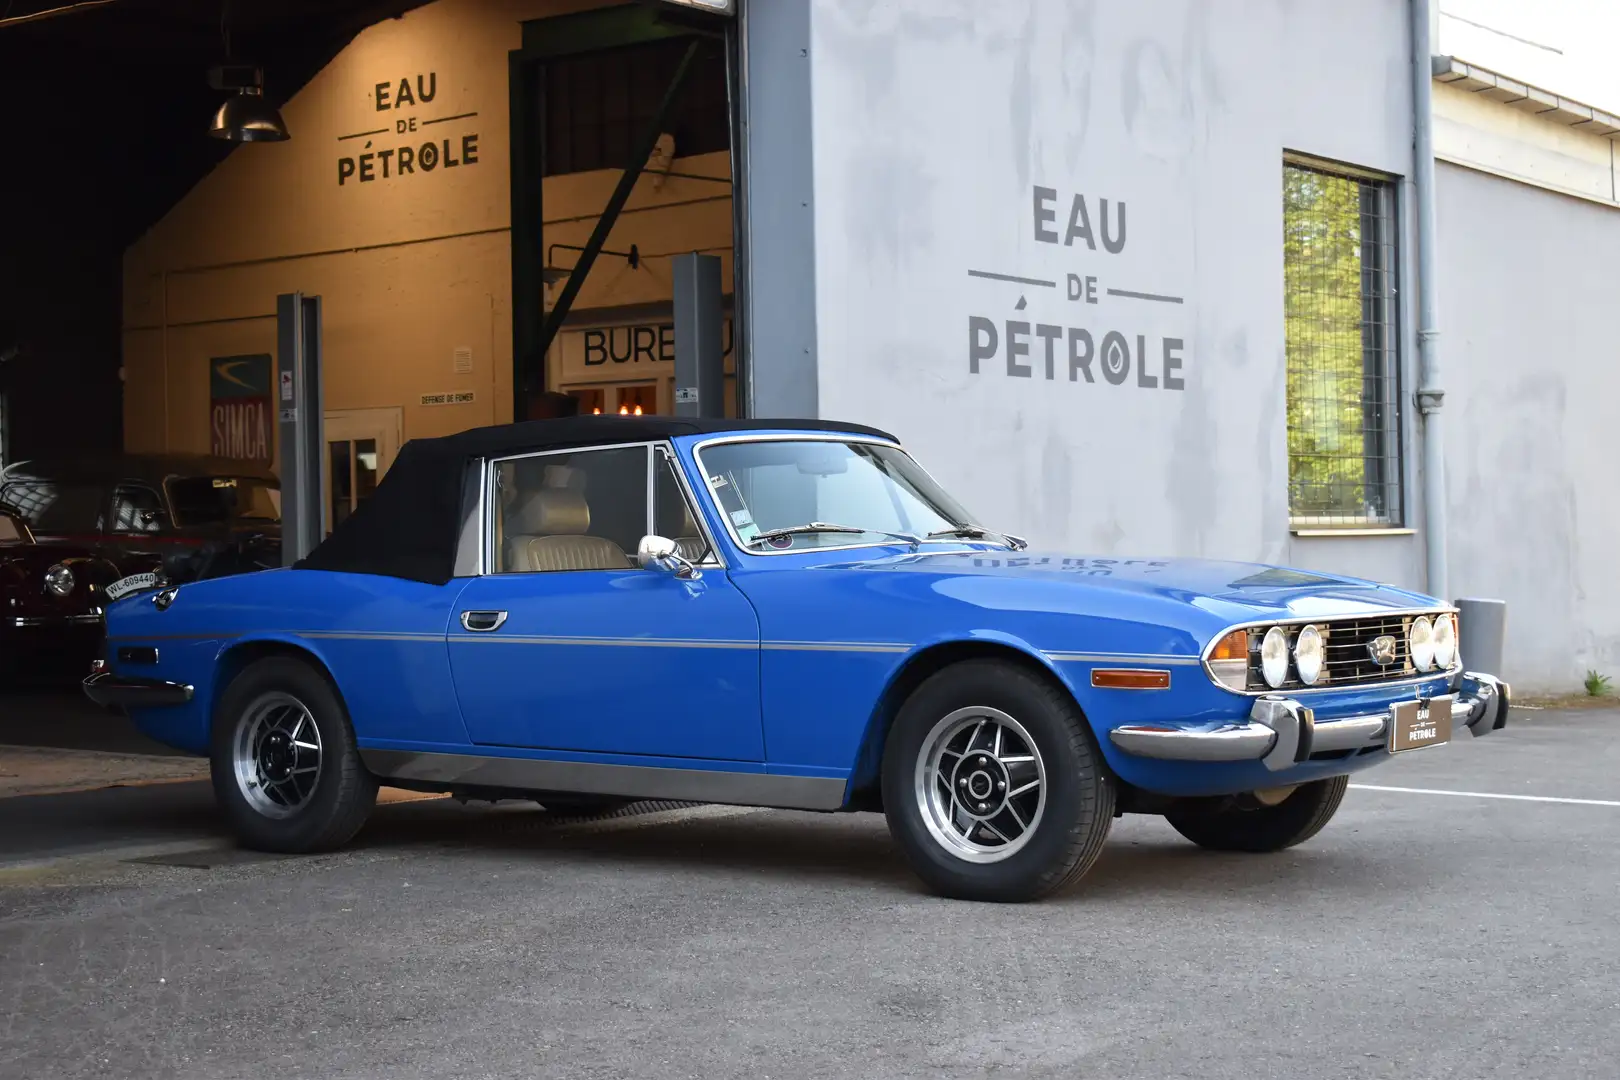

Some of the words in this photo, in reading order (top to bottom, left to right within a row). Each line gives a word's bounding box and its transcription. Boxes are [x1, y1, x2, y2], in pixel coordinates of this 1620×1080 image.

[375, 72, 436, 112] EAU
[396, 117, 417, 134] DE
[338, 134, 478, 186] PÉTROLE
[1033, 185, 1126, 254] EAU
[1067, 273, 1098, 304] DE
[585, 319, 734, 366] BUREU
[969, 295, 1185, 391] PÉTROLE
[447, 394, 454, 402] DE
[455, 393, 473, 402] FUMER
[213, 402, 267, 459] SIMCA
[108, 574, 154, 594] WL-609440
[1416, 710, 1430, 720] EAU
[1409, 728, 1436, 741] PÉTROLE
